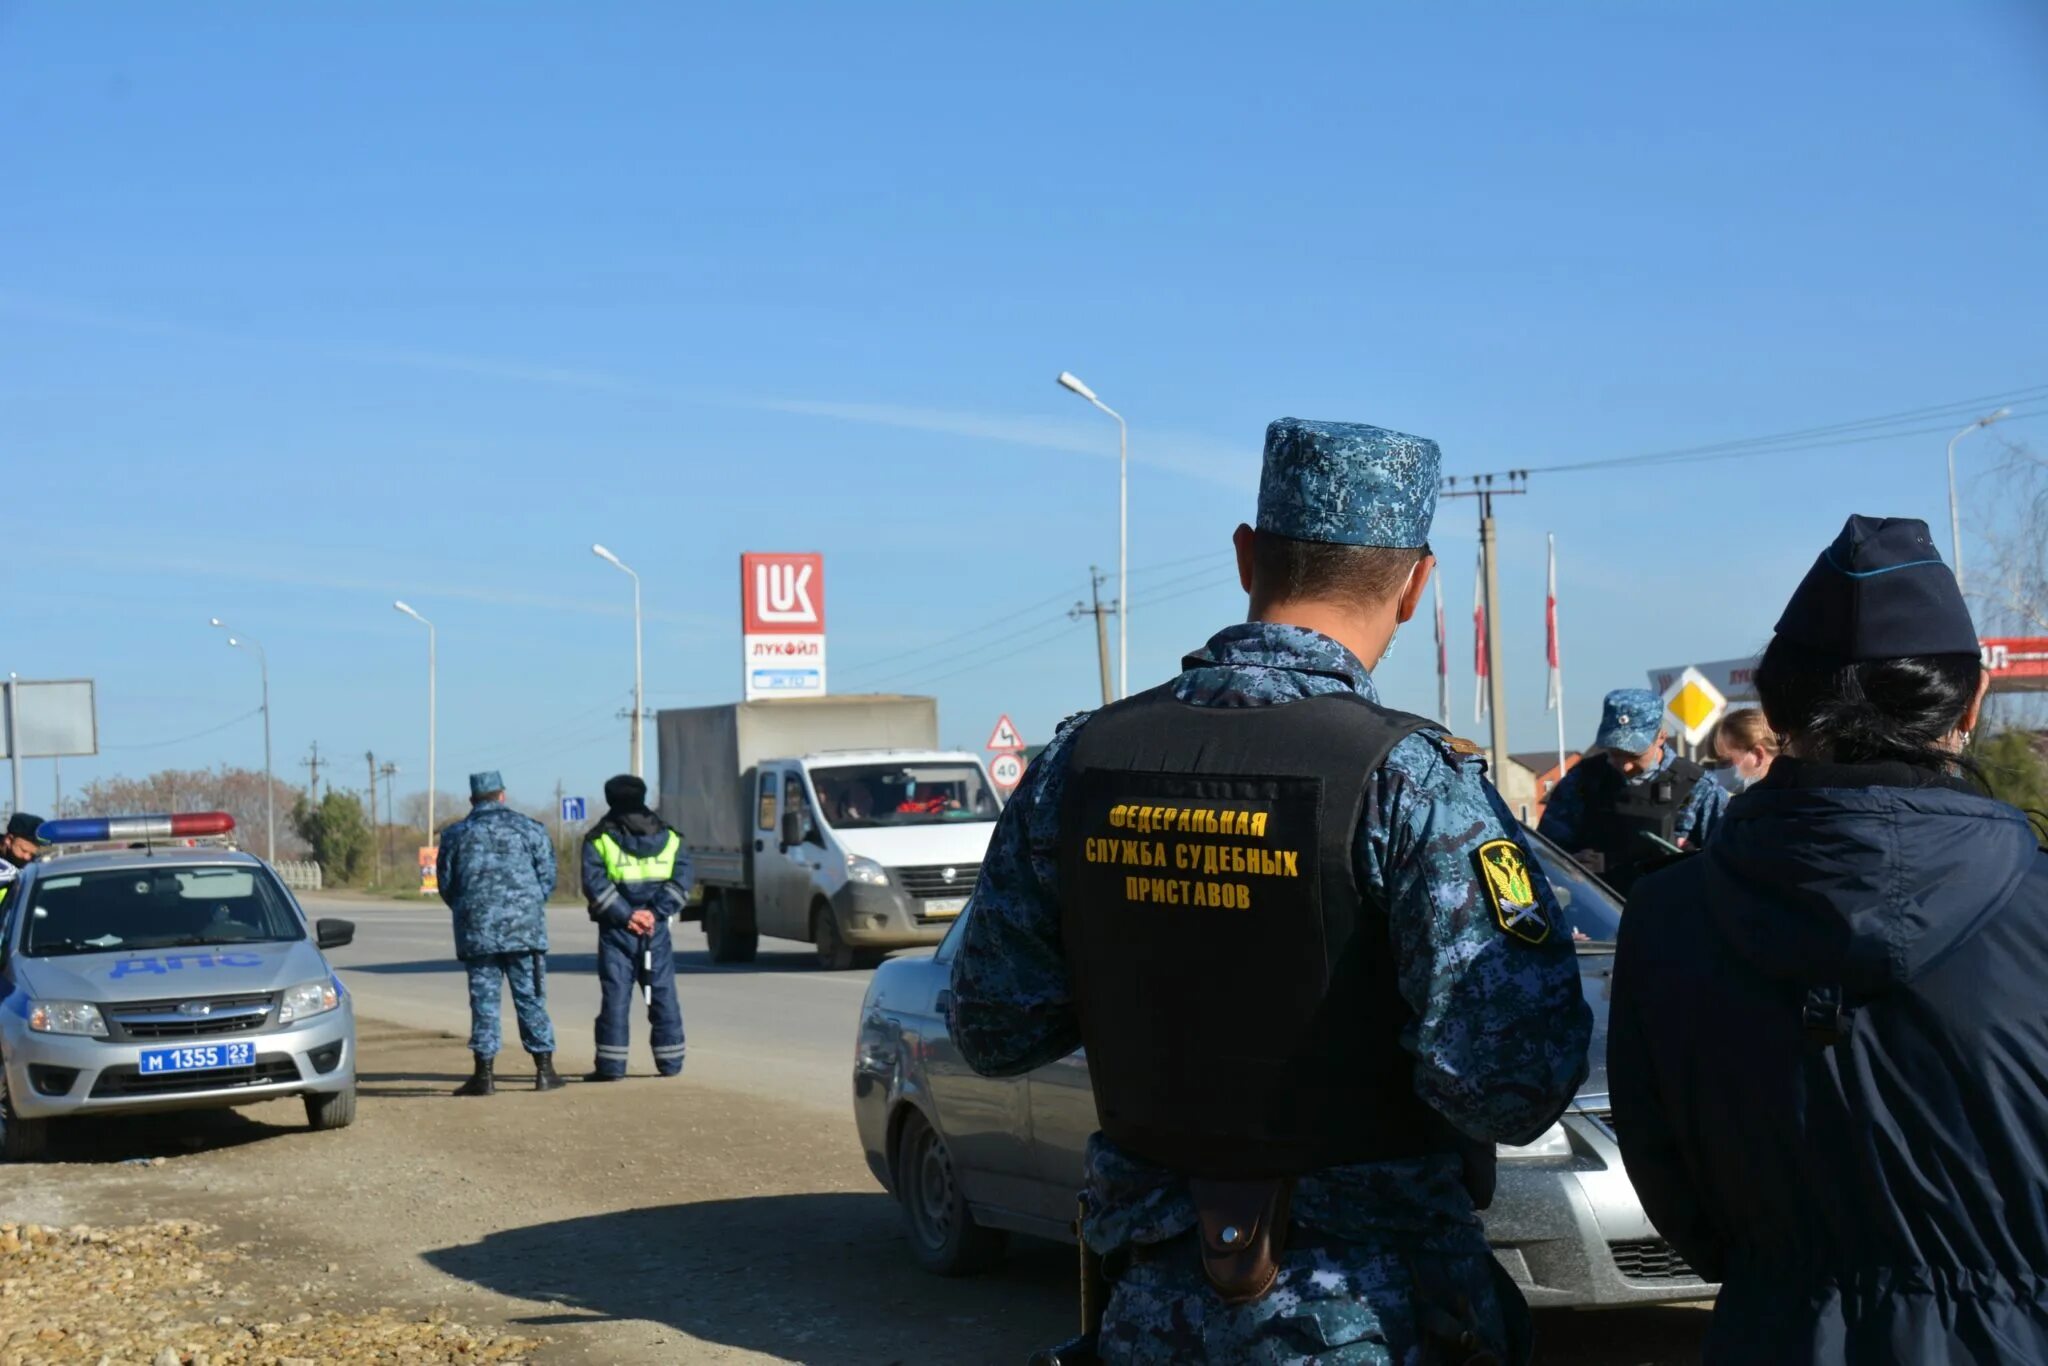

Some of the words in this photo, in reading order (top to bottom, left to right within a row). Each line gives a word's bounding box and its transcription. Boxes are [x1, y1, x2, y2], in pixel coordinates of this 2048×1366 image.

[756, 564, 818, 622] LUK
[753, 642, 819, 656] ЛУКОЙЛ
[997, 763, 1018, 777] 40
[1109, 804, 1268, 837] ФЕДЕРАЛЬНАЯ
[1085, 837, 1167, 868] СЛУЖБА
[1175, 843, 1298, 877] СУДЕБНЫХ
[1125, 876, 1251, 909] ПРИСТАВОВ
[109, 953, 264, 979] ДПС
[170, 1047, 218, 1068] 1355
[229, 1044, 249, 1059] 23
